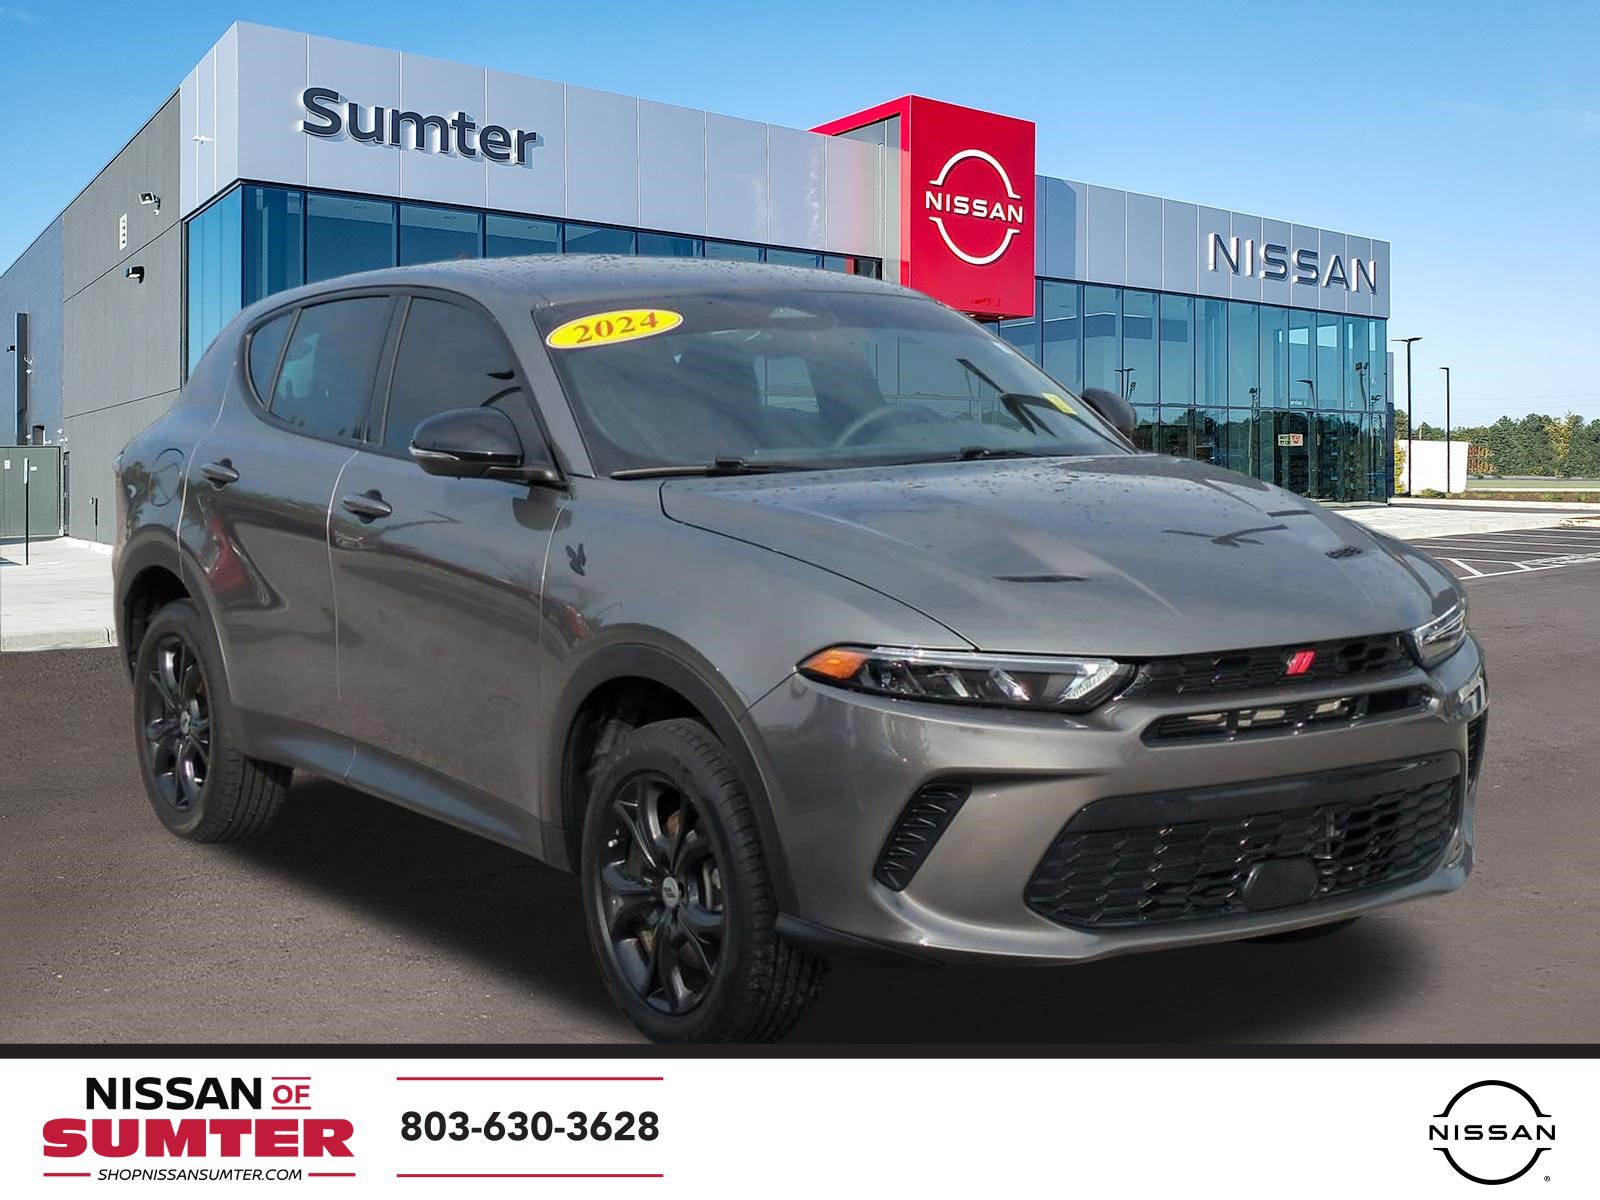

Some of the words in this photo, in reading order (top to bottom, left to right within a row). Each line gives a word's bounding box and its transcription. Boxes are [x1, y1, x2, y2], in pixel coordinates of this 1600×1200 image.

[302, 87, 537, 164] Sumter
[925, 190, 1023, 224] NISSAN
[1208, 232, 1377, 294] NISSAN
[573, 312, 659, 344] 2024
